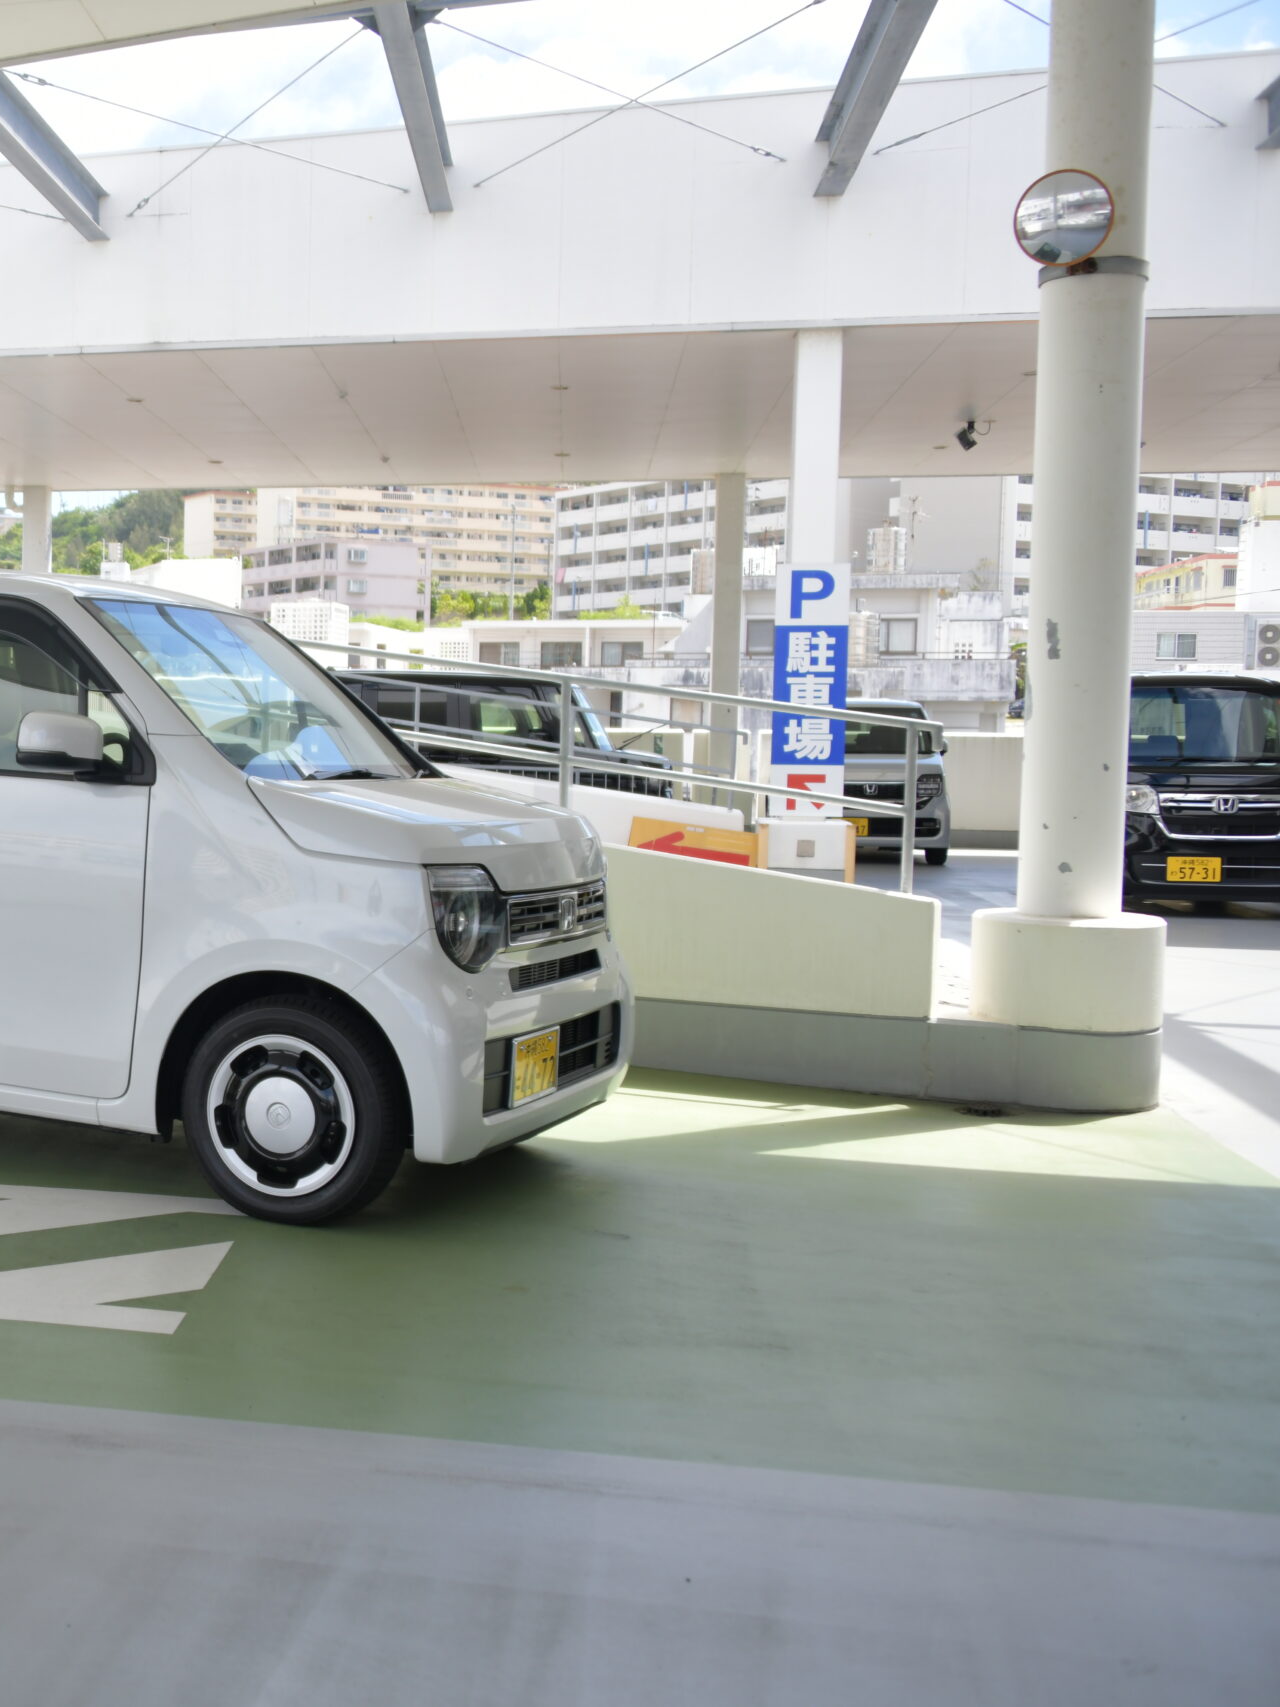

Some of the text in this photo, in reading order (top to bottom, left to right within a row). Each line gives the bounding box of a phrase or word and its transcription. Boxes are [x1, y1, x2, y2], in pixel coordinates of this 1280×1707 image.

[790, 570, 835, 619] P
[783, 631, 836, 760] 駐車場
[1179, 866, 1217, 880] 57-31
